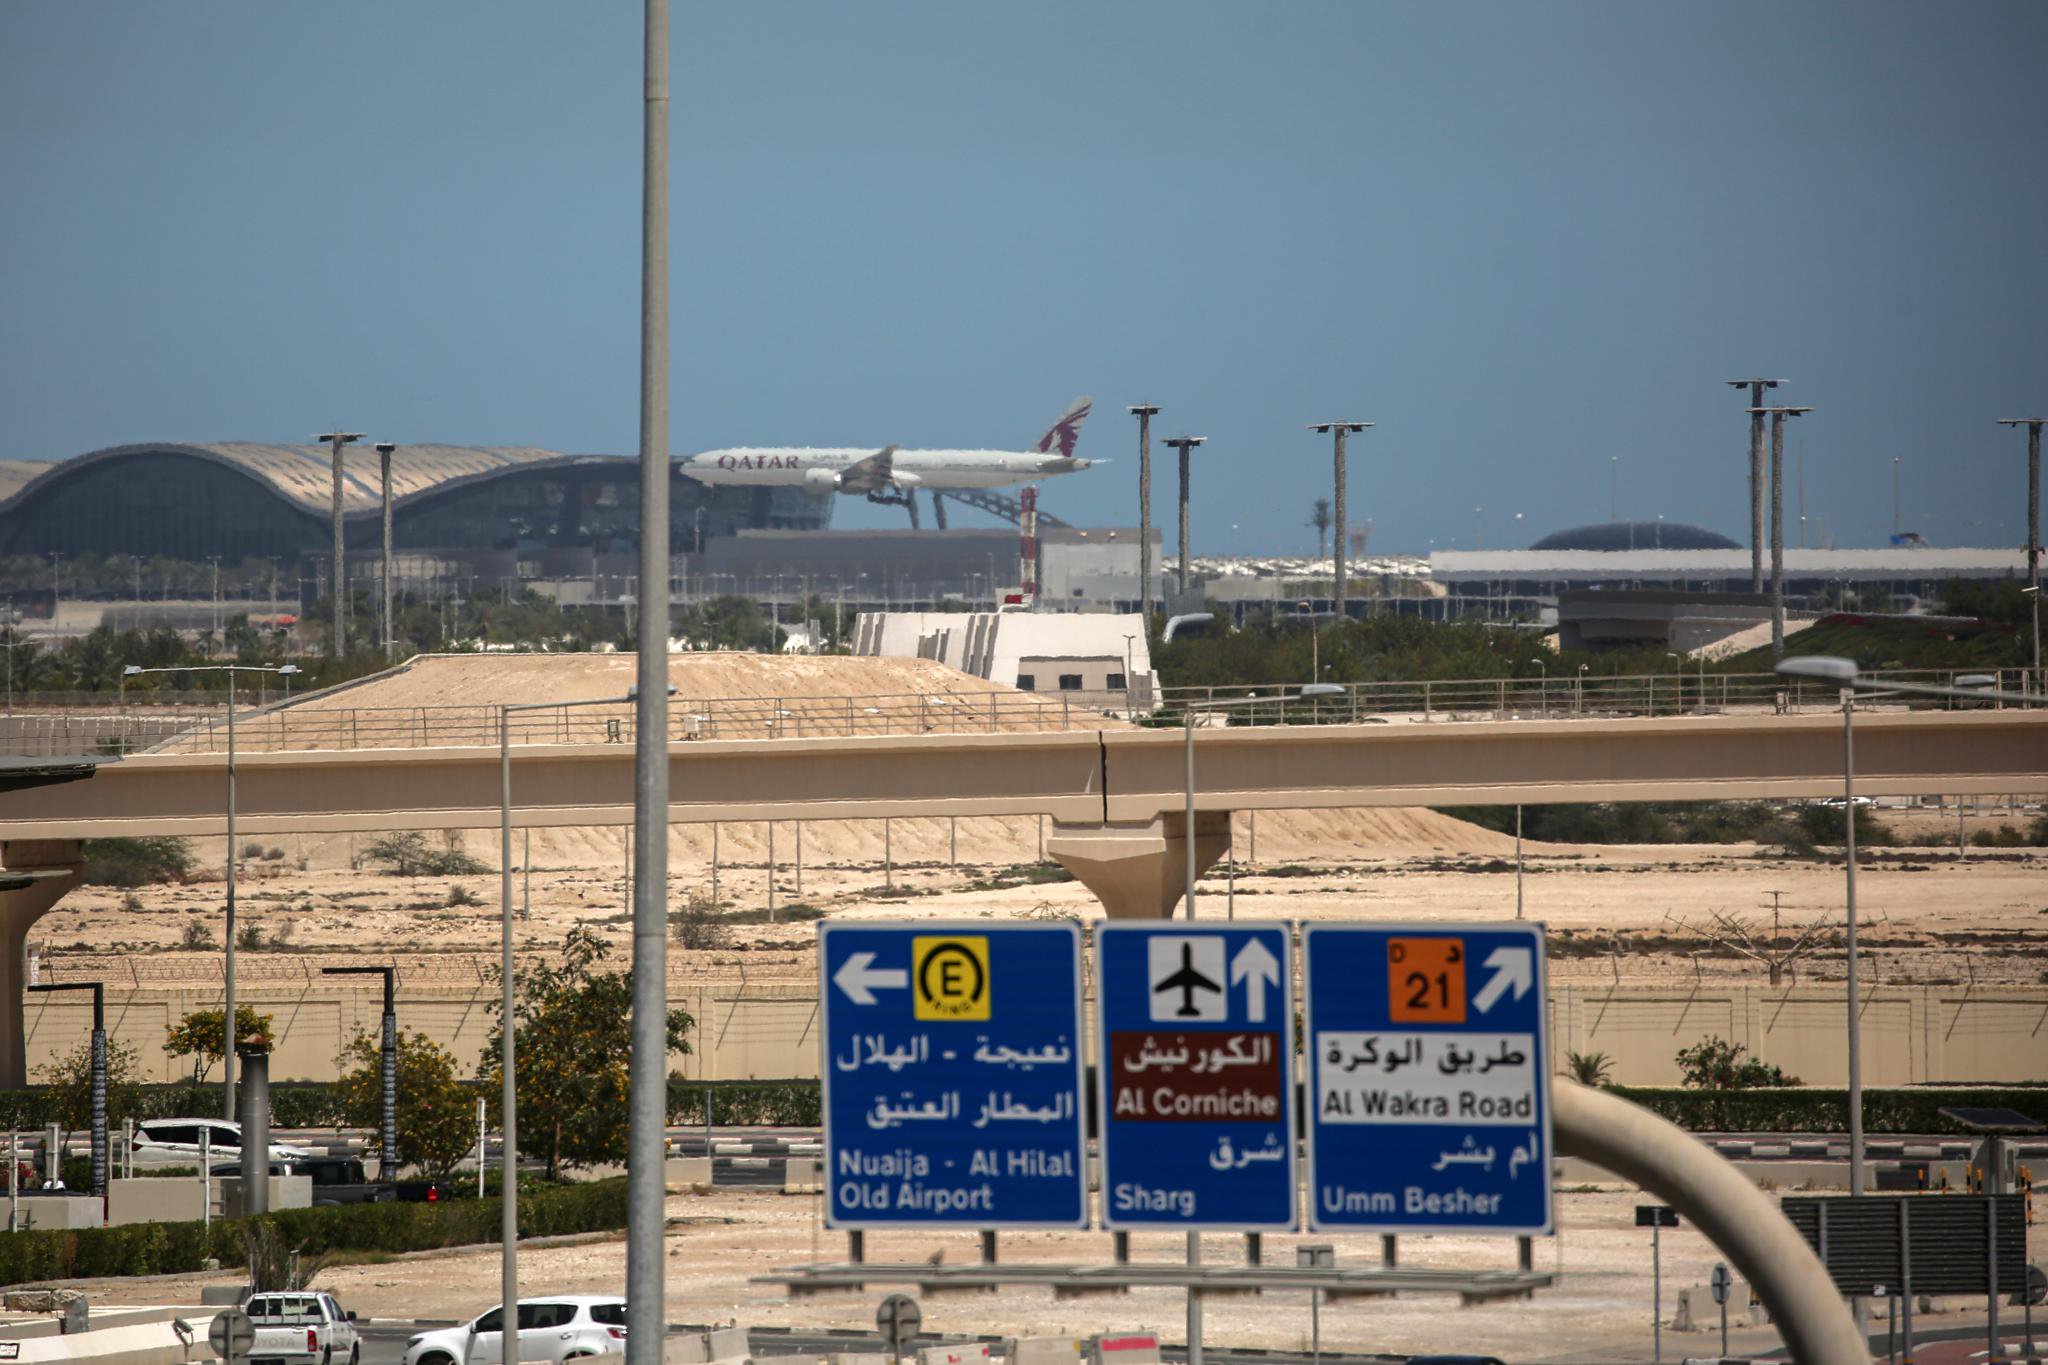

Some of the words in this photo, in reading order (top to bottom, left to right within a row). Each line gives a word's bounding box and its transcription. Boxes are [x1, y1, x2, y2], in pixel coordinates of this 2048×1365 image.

[718, 454, 799, 472] QATAR
[1389, 943, 1407, 963] D
[941, 960, 963, 997] E
[1406, 972, 1448, 1009] 21
[836, 1033, 929, 1072] الهلال
[973, 1034, 1072, 1072] نعيجة
[1123, 1034, 1272, 1073] الكورنيش
[1326, 1035, 1423, 1073] الوكرة
[1438, 1039, 1526, 1075] طريق
[866, 1090, 961, 1130] العتيق
[971, 1090, 1075, 1128] المطار
[1115, 1087, 1147, 1116] Al
[1152, 1087, 1279, 1117] Corniche
[1323, 1088, 1353, 1117] Al
[1361, 1090, 1449, 1118] Wakra
[1457, 1090, 1532, 1119] Road
[838, 1149, 930, 1181] Nuaija
[969, 1149, 1001, 1177] Al
[1006, 1149, 1074, 1178] Hilal
[1209, 1131, 1286, 1171] شرق
[1430, 1133, 1496, 1172] بشر
[838, 1181, 890, 1210] Old
[896, 1180, 995, 1215] Airport
[1114, 1182, 1196, 1217] Sharg
[1322, 1184, 1396, 1213] Umm
[1404, 1186, 1502, 1215] Besher
[255, 1336, 296, 1348] YOTA
